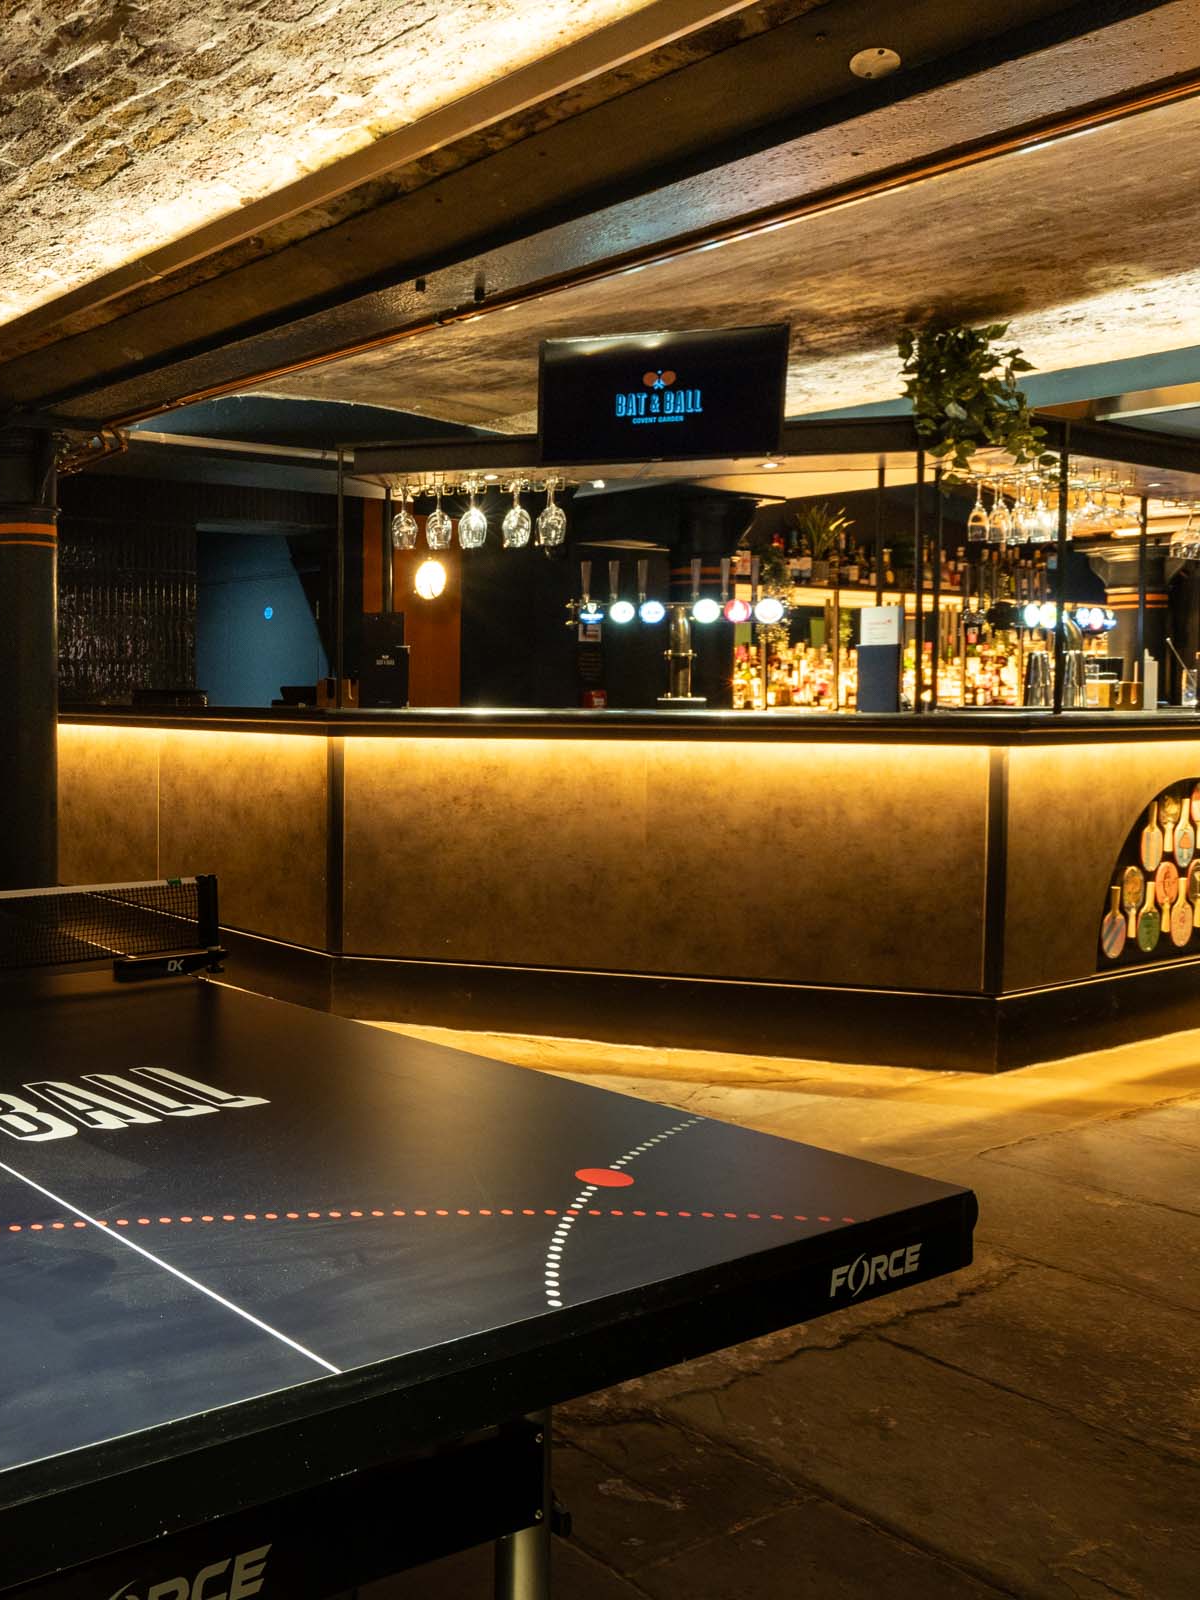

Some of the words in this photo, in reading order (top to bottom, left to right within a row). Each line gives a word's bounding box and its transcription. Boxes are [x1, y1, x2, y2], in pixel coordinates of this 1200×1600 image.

[615, 392, 647, 417] BAT
[650, 394, 660, 413] &
[663, 389, 703, 414] BALL
[657, 415, 684, 423] GARDEN
[829, 1243, 922, 1298] FORCE
